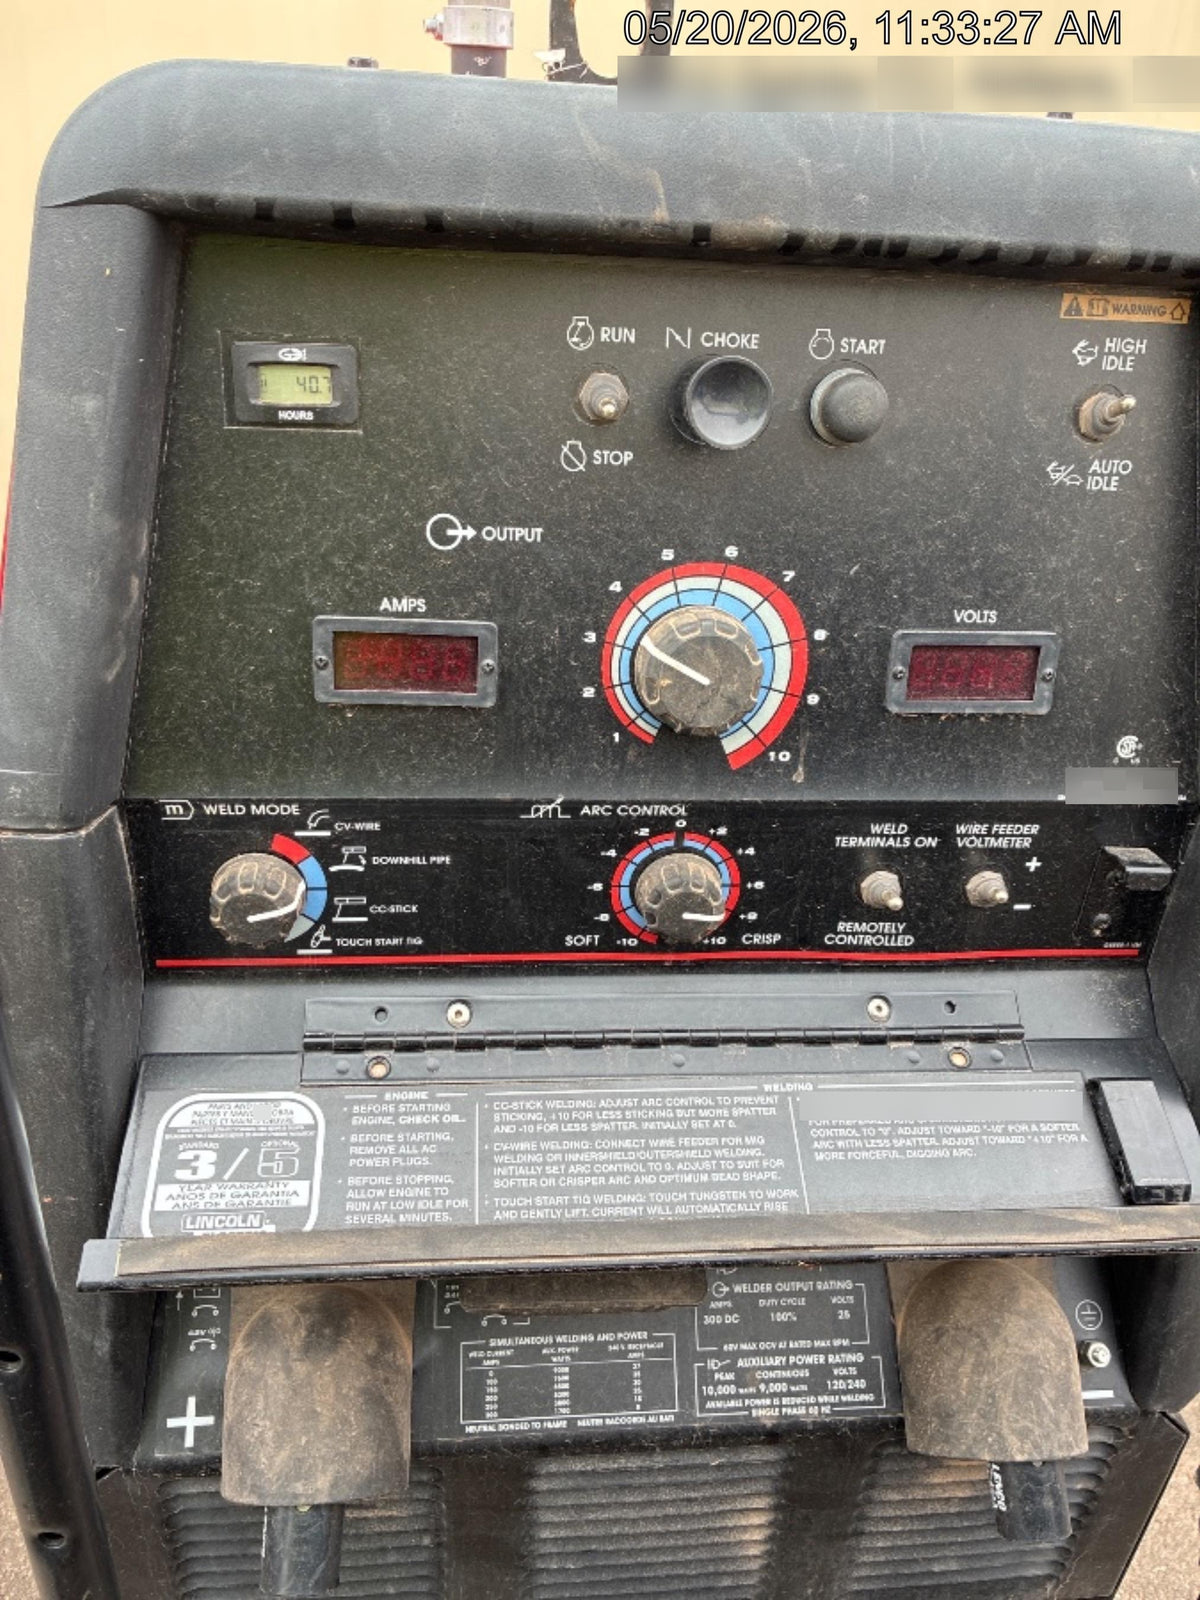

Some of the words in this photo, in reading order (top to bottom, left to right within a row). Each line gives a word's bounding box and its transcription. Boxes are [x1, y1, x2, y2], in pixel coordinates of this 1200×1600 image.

[1112, 305, 1167, 317] WARNING
[601, 327, 636, 343] RUN
[701, 332, 759, 349] CHOKE
[840, 338, 885, 354] START
[1104, 337, 1147, 354] HIGH
[1102, 355, 1135, 371] IDLE
[278, 410, 314, 421] HOURS
[593, 450, 633, 466] STOP
[1088, 460, 1133, 475] AUTO
[1087, 477, 1119, 491] IDLE
[482, 527, 543, 543] OUTPUT
[661, 549, 674, 560] 5
[725, 545, 738, 557] 6
[782, 571, 795, 582] 7
[609, 581, 622, 592] 4
[379, 598, 426, 612] AMPS
[954, 610, 997, 623] VOLTS
[583, 632, 596, 643] 3
[582, 687, 595, 698] 2
[612, 732, 620, 743] 1
[768, 751, 791, 762] 10
[204, 804, 246, 816] WELD
[252, 804, 300, 816] MODE
[580, 805, 612, 816] ARC
[617, 804, 688, 817] CONTROL
[335, 822, 381, 831] CV-WIRE
[676, 819, 687, 828] 0
[870, 823, 908, 834] WELD
[956, 824, 988, 835] WIRE
[992, 824, 1040, 835] FEEDER
[835, 836, 911, 848] TERMINALS
[914, 837, 938, 848] ON
[957, 837, 1032, 848] VOLTMETER
[372, 856, 427, 865] DOWNHILL
[430, 856, 450, 865] PIPE
[369, 904, 418, 914] CC-STICK
[837, 922, 906, 933] REMOTELY
[336, 938, 372, 947] TOUCH
[375, 937, 403, 946] START
[406, 937, 423, 945] TIG
[565, 935, 600, 946] SOFT
[742, 933, 782, 946] CRISP
[824, 934, 915, 947] CONTROLLED
[763, 1083, 813, 1092] WELDING
[384, 1091, 429, 1100] ENGINE
[494, 1100, 543, 1110] CC-STICK
[546, 1099, 596, 1109] WELDING:
[599, 1098, 639, 1108] ADJUST
[641, 1098, 663, 1107] ARC
[665, 1097, 715, 1107] CONTROL
[717, 1096, 732, 1105] TO
[734, 1095, 779, 1105] PREVENT
[353, 1104, 396, 1114] BEFORE
[398, 1103, 451, 1112] STARTING
[398, 1114, 440, 1125] CHECK
[350, 1134, 394, 1143] BEFORE
[494, 1141, 537, 1151] CV-WIRE
[540, 1140, 592, 1150] WELDING:
[595, 1139, 646, 1149] CONNECT
[649, 1138, 676, 1148] WIRE
[679, 1137, 719, 1147] FEEDER
[721, 1136, 743, 1146] FOR
[744, 1135, 765, 1145] MIG
[350, 1145, 396, 1155] REMOVE
[398, 1145, 418, 1154] ALL
[421, 1144, 437, 1153] AC
[815, 1151, 845, 1161] MORE
[907, 1149, 950, 1158] DIGGING
[174, 1150, 217, 1181] 3
[257, 1148, 300, 1177] 5
[350, 1157, 390, 1167] POWER
[348, 1176, 393, 1186] BEFORE
[178, 1184, 212, 1192] YEAR
[216, 1182, 290, 1190] WARRANTY
[346, 1189, 386, 1198] ALLOW
[388, 1187, 432, 1197] ENGINE
[434, 1187, 448, 1196] TO
[209, 1192, 226, 1200] DE
[494, 1197, 532, 1207] TOUCH
[535, 1196, 569, 1206] START
[571, 1195, 591, 1205] TIG
[594, 1194, 646, 1204] WELDING:
[649, 1192, 687, 1202] TOUCH
[690, 1190, 747, 1201] TUNGSTEN
[749, 1190, 763, 1199] TO
[766, 1189, 799, 1199] WORK
[172, 1202, 200, 1210] ANS
[203, 1201, 221, 1209] DE
[346, 1202, 370, 1211] RUN
[373, 1201, 386, 1210] AT
[390, 1200, 415, 1210] LOW
[418, 1199, 444, 1209] IDLE
[446, 1198, 468, 1208] FOR
[185, 1214, 261, 1229] LINCOLN
[344, 1214, 396, 1224] SEVERAL
[732, 1282, 773, 1294] WELDER
[775, 1281, 814, 1292] OUTPUT
[816, 1280, 853, 1290] RATING
[759, 1299, 778, 1307] DUTY
[780, 1298, 806, 1306] CYCLE
[831, 1296, 854, 1304] VOLTS
[703, 1315, 722, 1325] 300
[725, 1314, 740, 1323] DC
[770, 1312, 797, 1322] 100%
[489, 1336, 553, 1347] SIMULTANEOUS
[555, 1333, 594, 1344] WELDING
[597, 1332, 615, 1342] AND
[617, 1331, 648, 1341] POWER
[737, 1357, 786, 1368] AUXILIARY
[789, 1355, 825, 1365] POWER
[828, 1353, 864, 1363] RATING
[715, 1372, 735, 1380] PEAK
[755, 1369, 809, 1379] CONTINUOUS
[832, 1367, 857, 1376] VOLTS
[702, 1385, 737, 1396] 10,000
[759, 1383, 788, 1393] 9,000
[827, 1380, 866, 1390] 120/240
